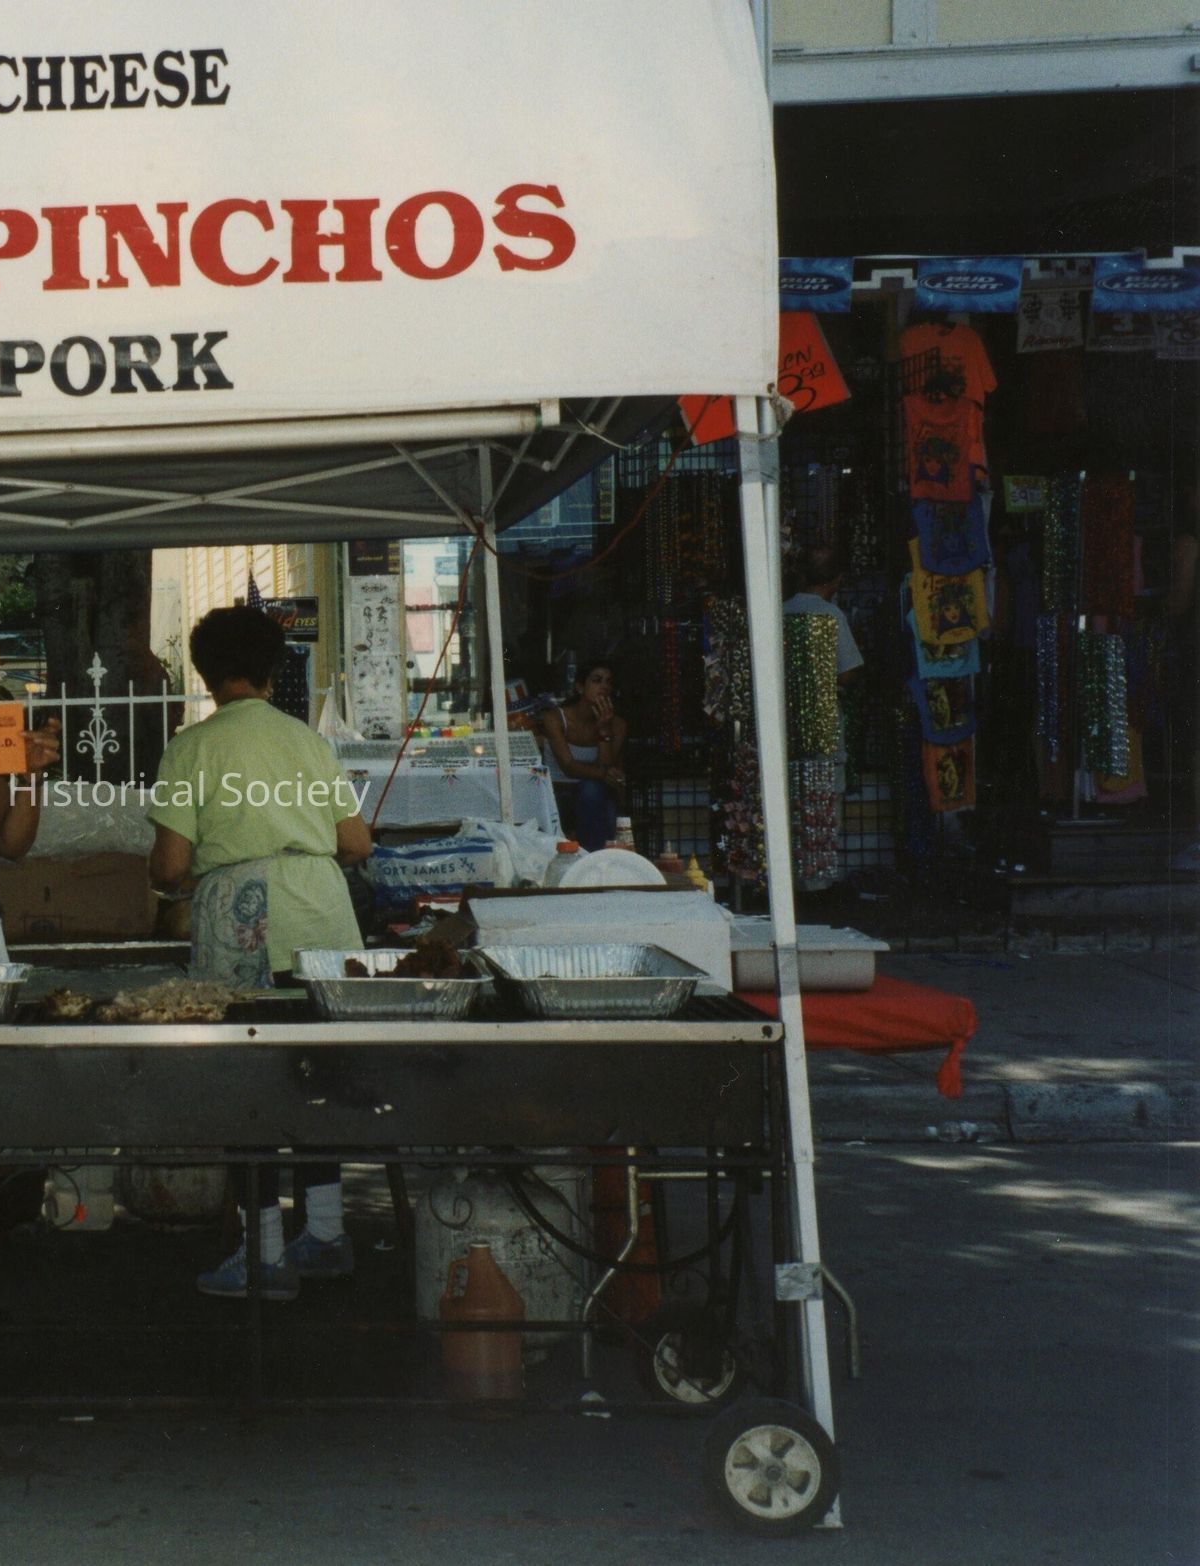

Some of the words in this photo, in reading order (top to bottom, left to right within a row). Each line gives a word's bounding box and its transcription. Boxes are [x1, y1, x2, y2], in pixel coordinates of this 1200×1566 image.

[945, 275, 995, 283] BUD
[1123, 275, 1177, 283] BUD
[932, 282, 1003, 291] LIGHT
[1111, 282, 1184, 291] LIGHT
[380, 865, 407, 876] ORT
[413, 862, 456, 875] JAMES
